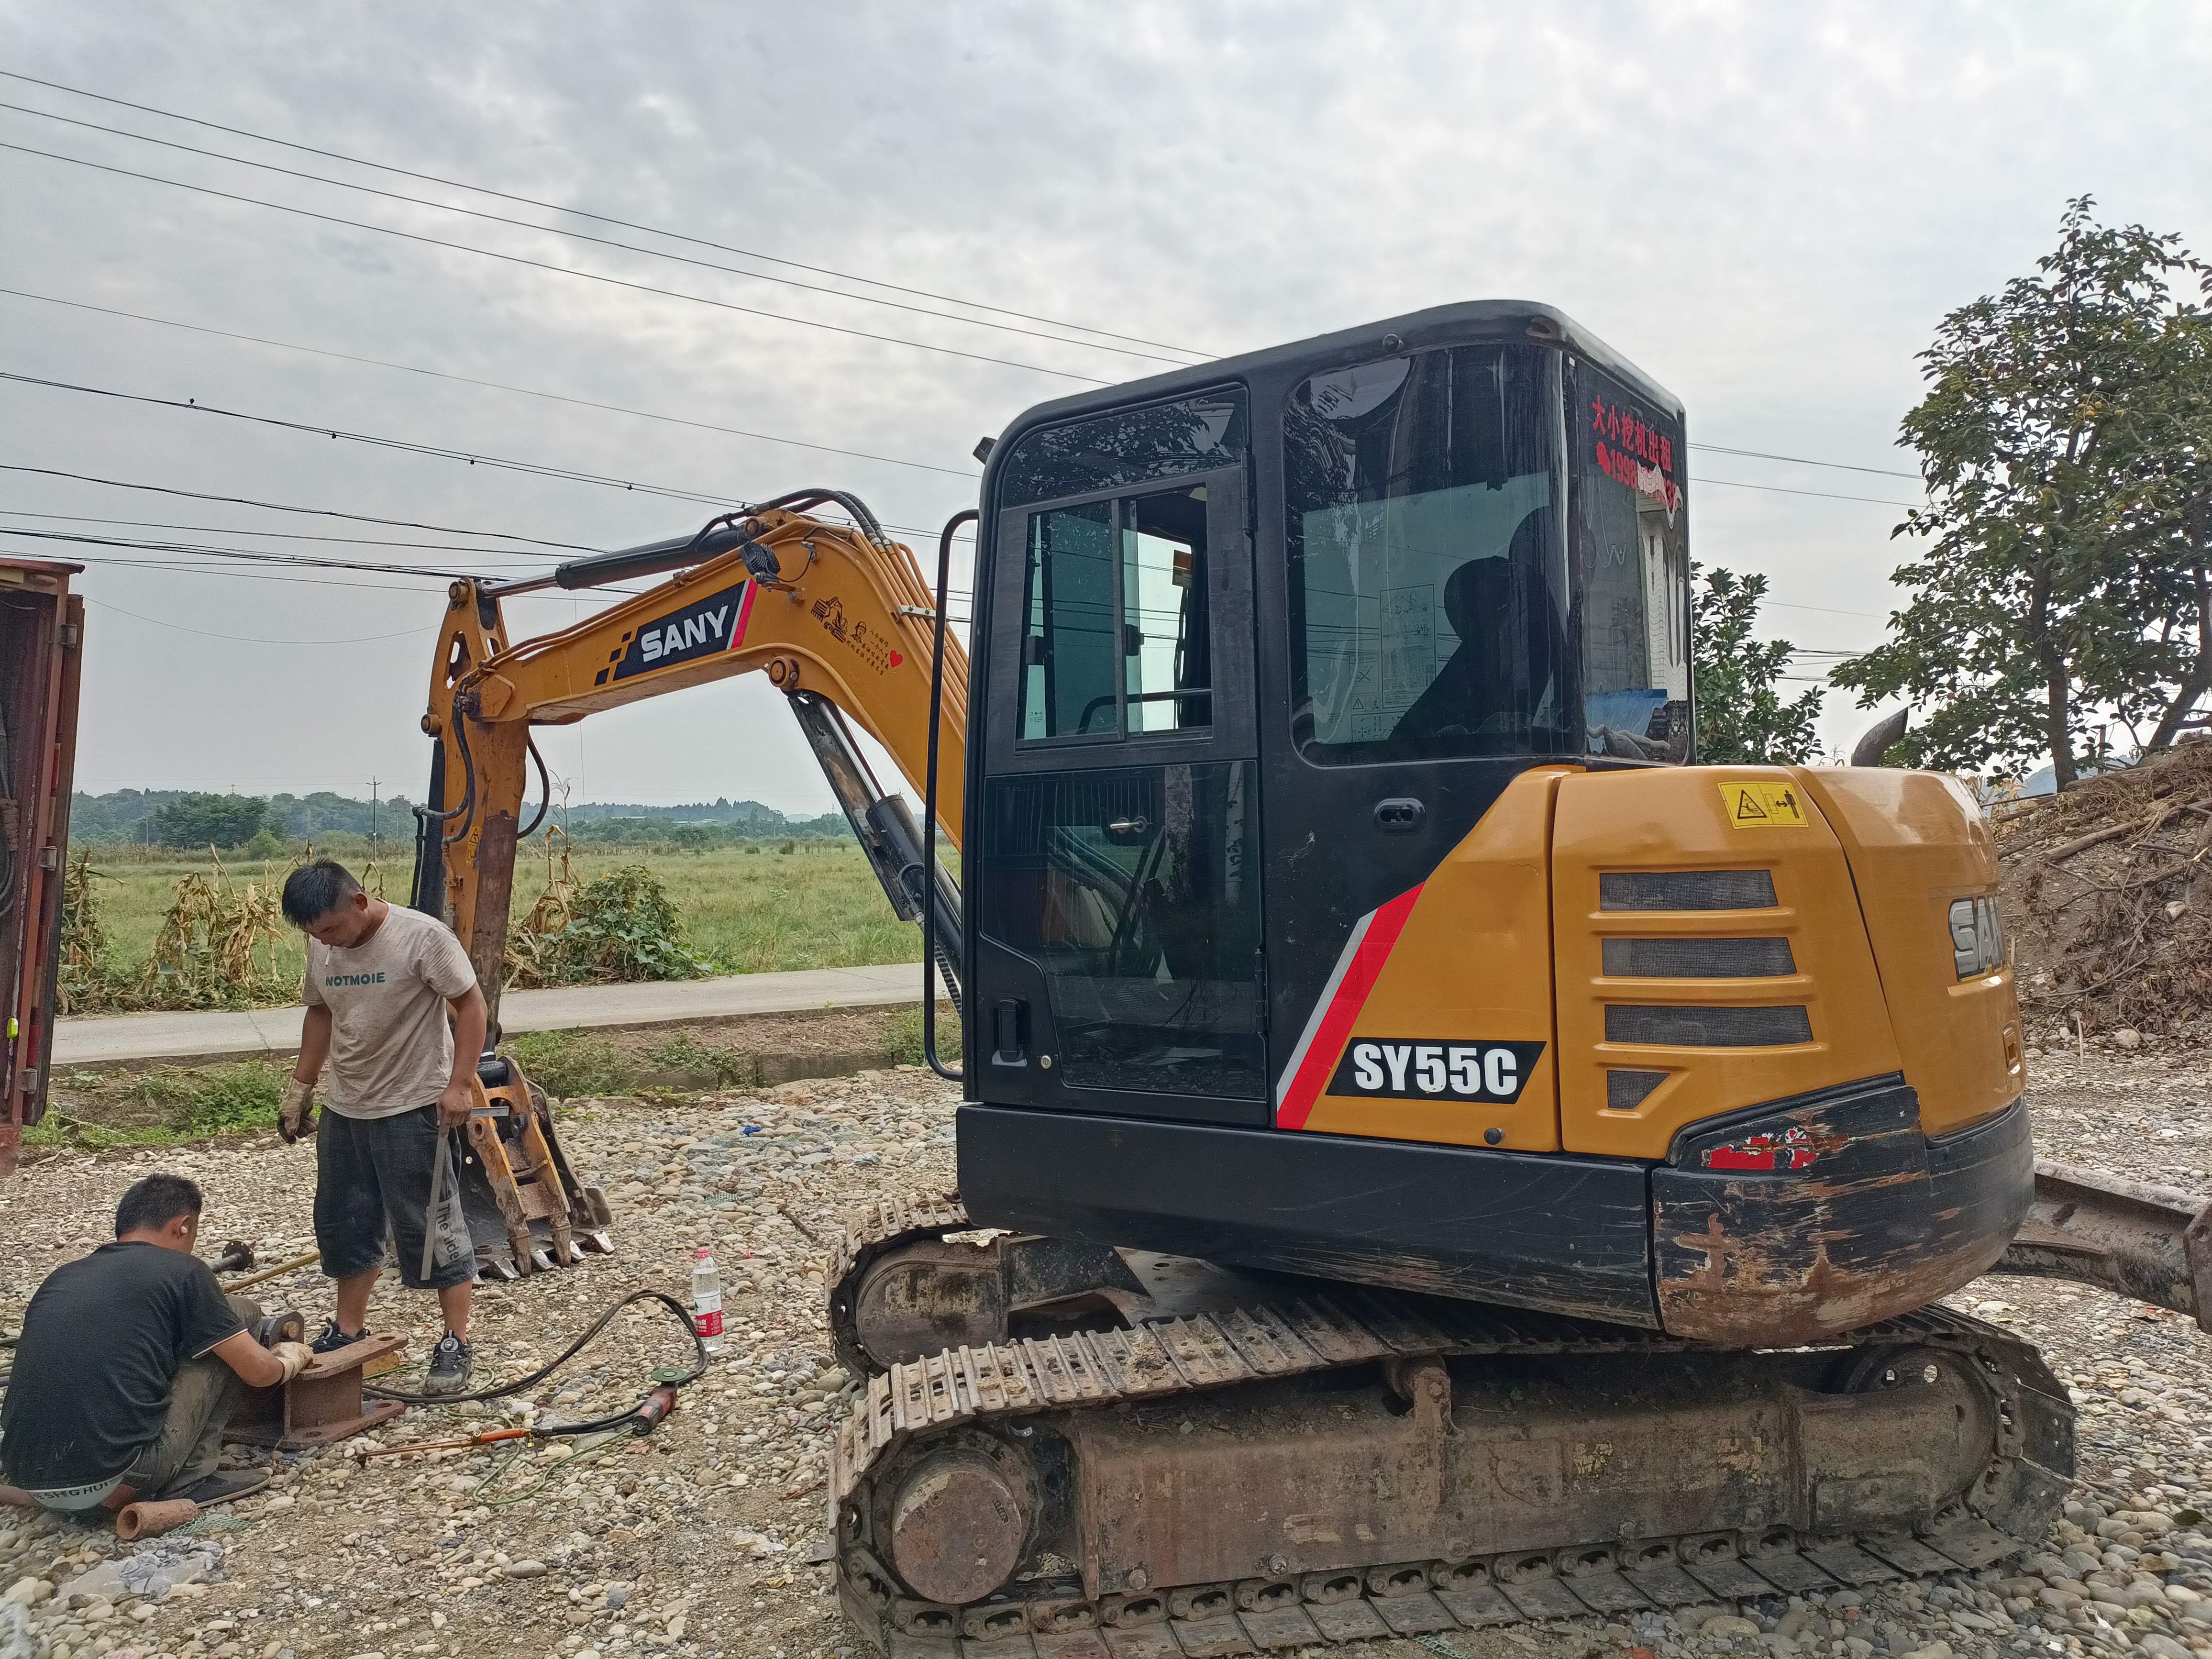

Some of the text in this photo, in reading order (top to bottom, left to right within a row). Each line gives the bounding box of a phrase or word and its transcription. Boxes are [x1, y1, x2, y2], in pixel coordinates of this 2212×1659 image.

[1593, 395, 1672, 472] 大小挖机出租
[641, 605, 729, 663] SANY
[326, 972, 386, 986] NOTMOIE
[1353, 1043, 1517, 1095] SY55C
[437, 1203, 460, 1261] The tide
